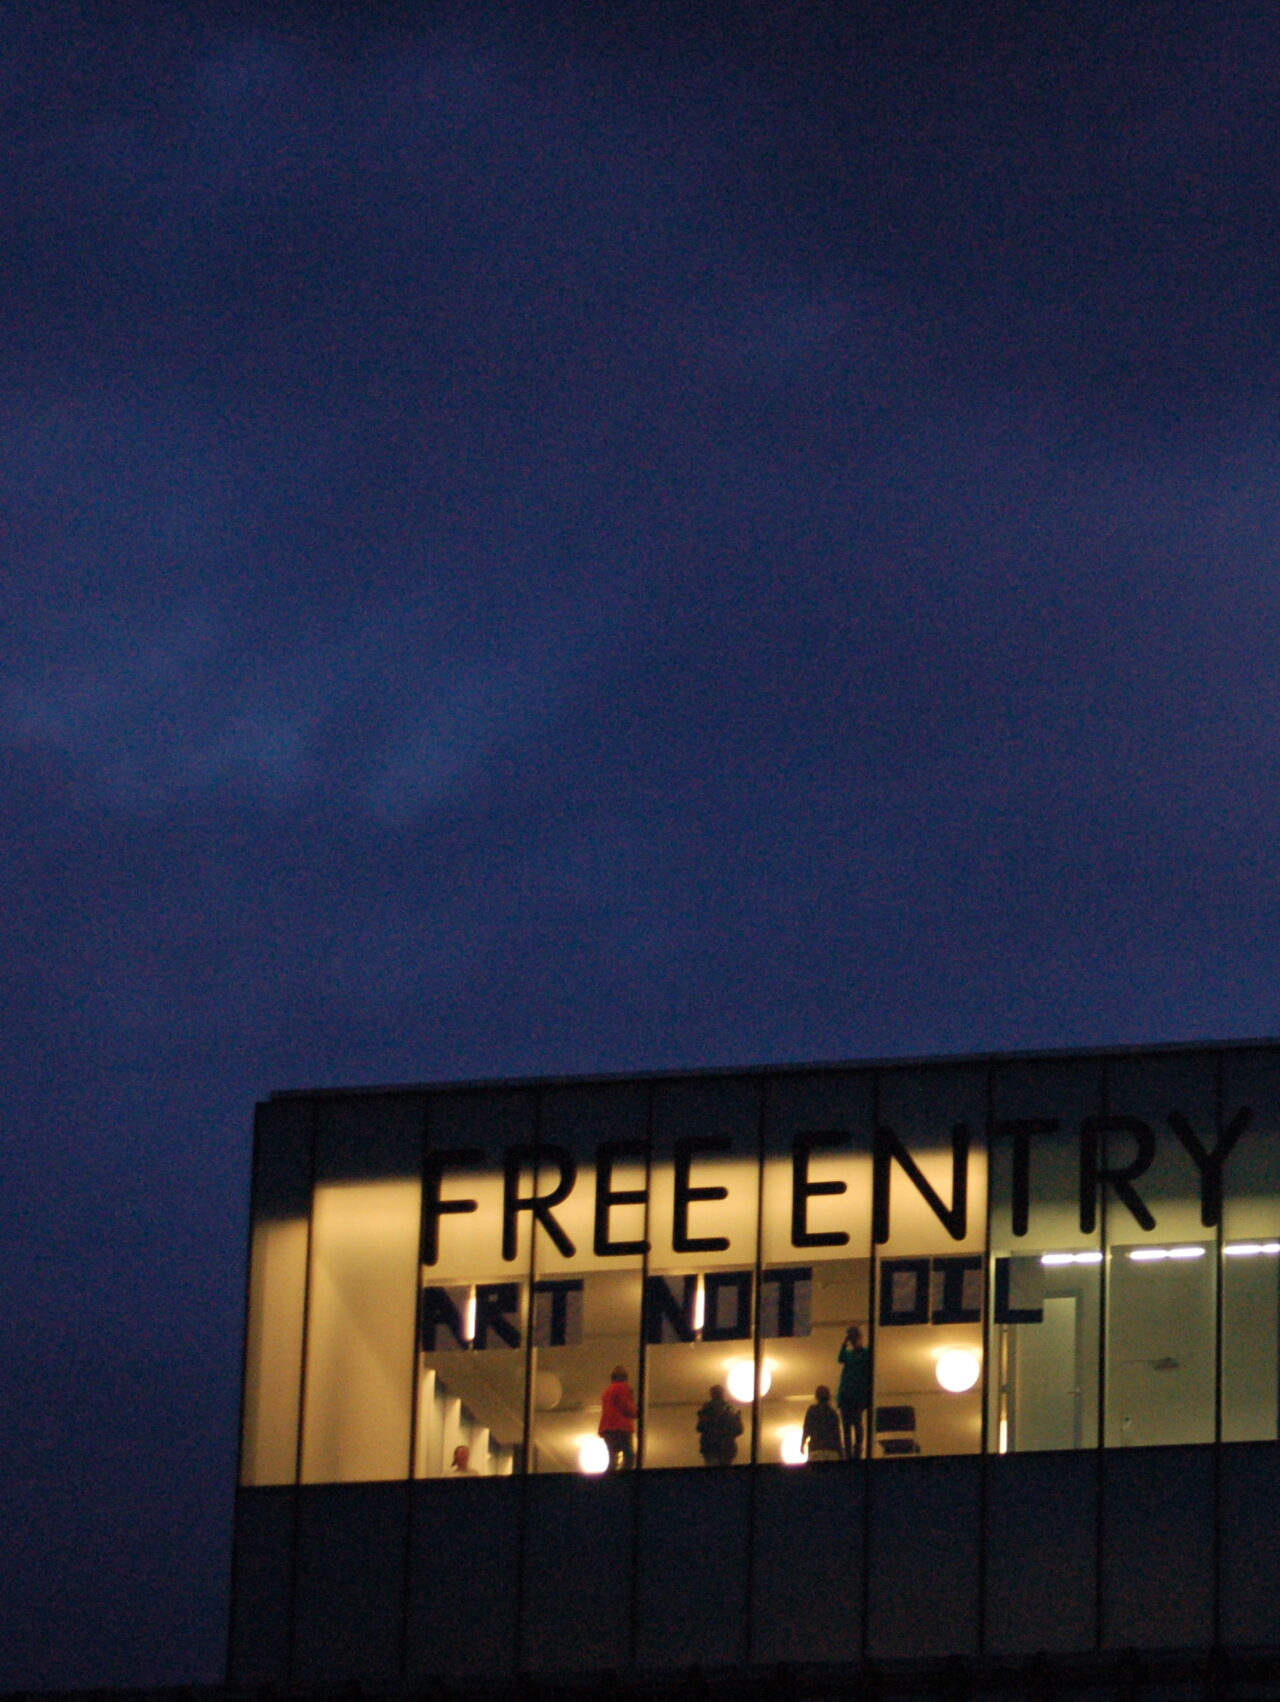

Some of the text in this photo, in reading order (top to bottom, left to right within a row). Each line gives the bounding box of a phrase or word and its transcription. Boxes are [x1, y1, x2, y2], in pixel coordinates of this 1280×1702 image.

[422, 1137, 732, 1265] FREE
[792, 1107, 1252, 1248] ENTRY
[422, 1255, 1043, 1351] ART NOT OIL
